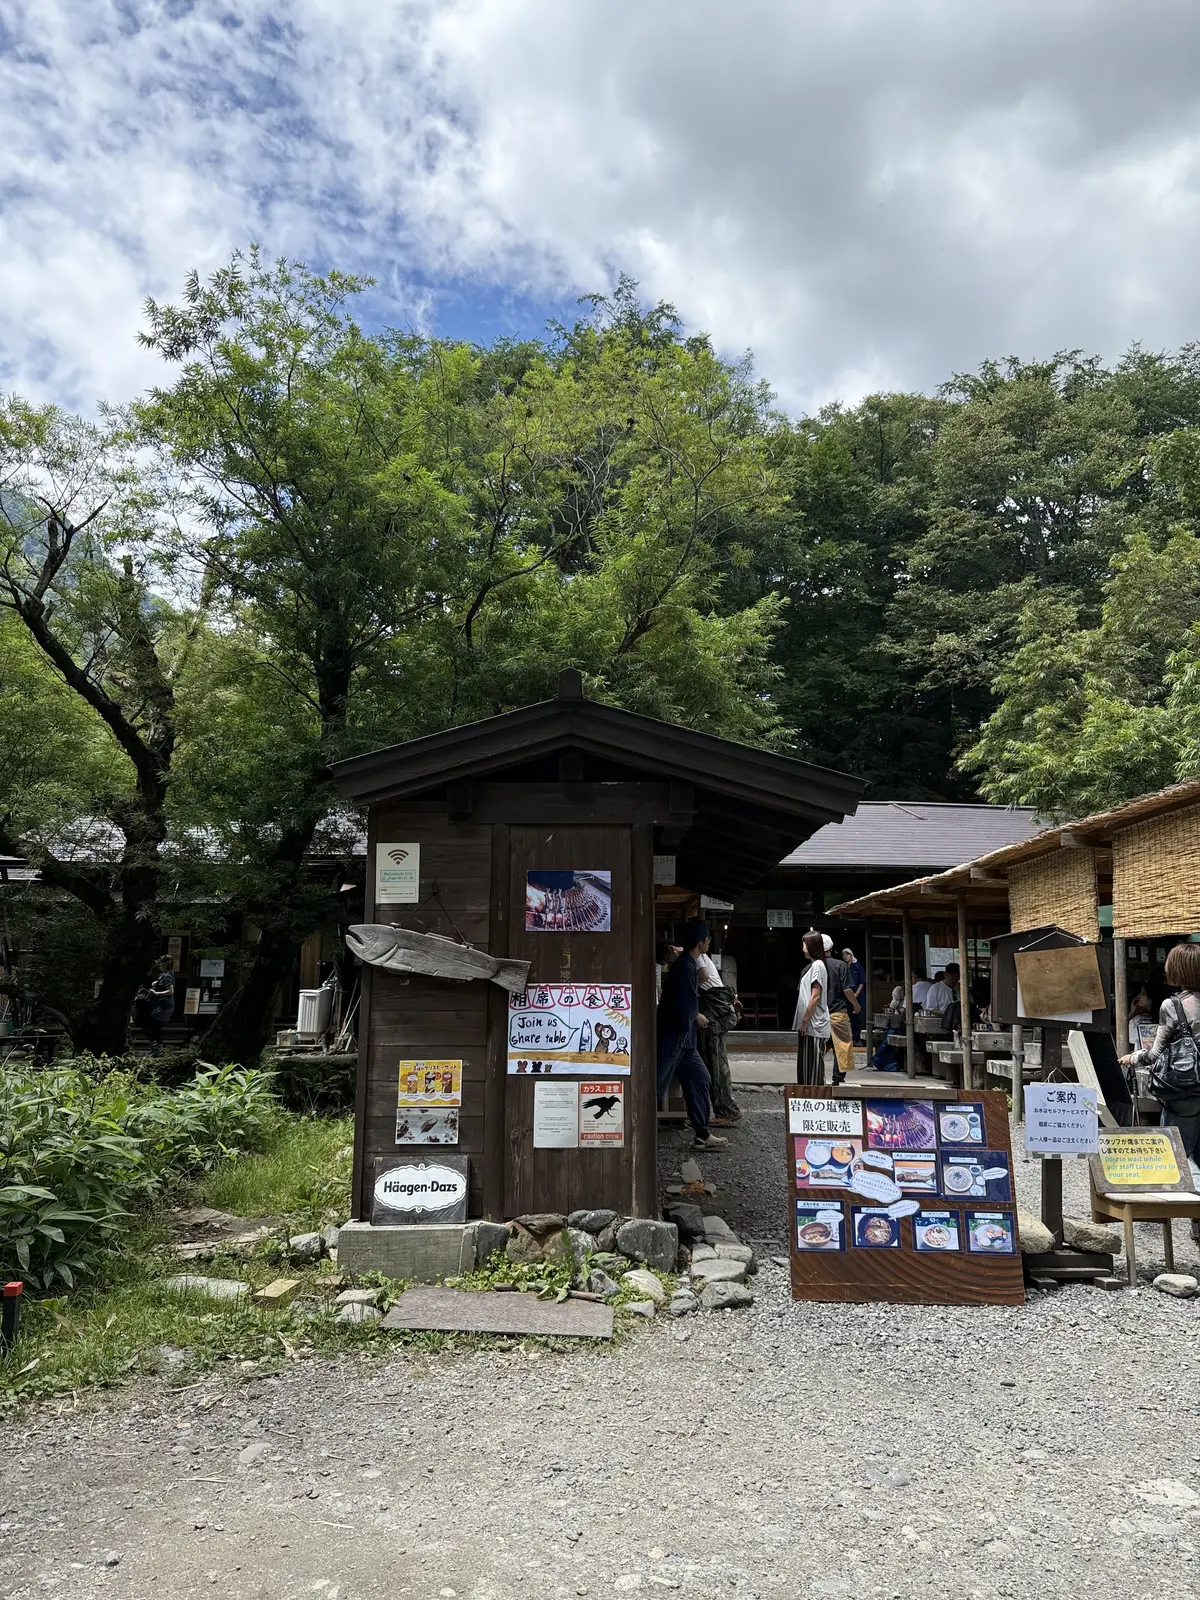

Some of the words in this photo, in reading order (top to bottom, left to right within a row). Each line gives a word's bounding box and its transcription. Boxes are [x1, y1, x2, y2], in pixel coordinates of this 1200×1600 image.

[511, 991, 625, 1009] 相席の食堂
[518, 1017, 542, 1028] Join
[547, 1018, 558, 1027] us
[511, 1032, 541, 1046] share
[546, 1030, 566, 1043] table
[1046, 1090, 1077, 1104] ご案内
[790, 1100, 861, 1114] 岩魚の塩焼き
[1034, 1107, 1089, 1115] お水はセルフサービスです
[803, 1119, 851, 1133] 限定販売
